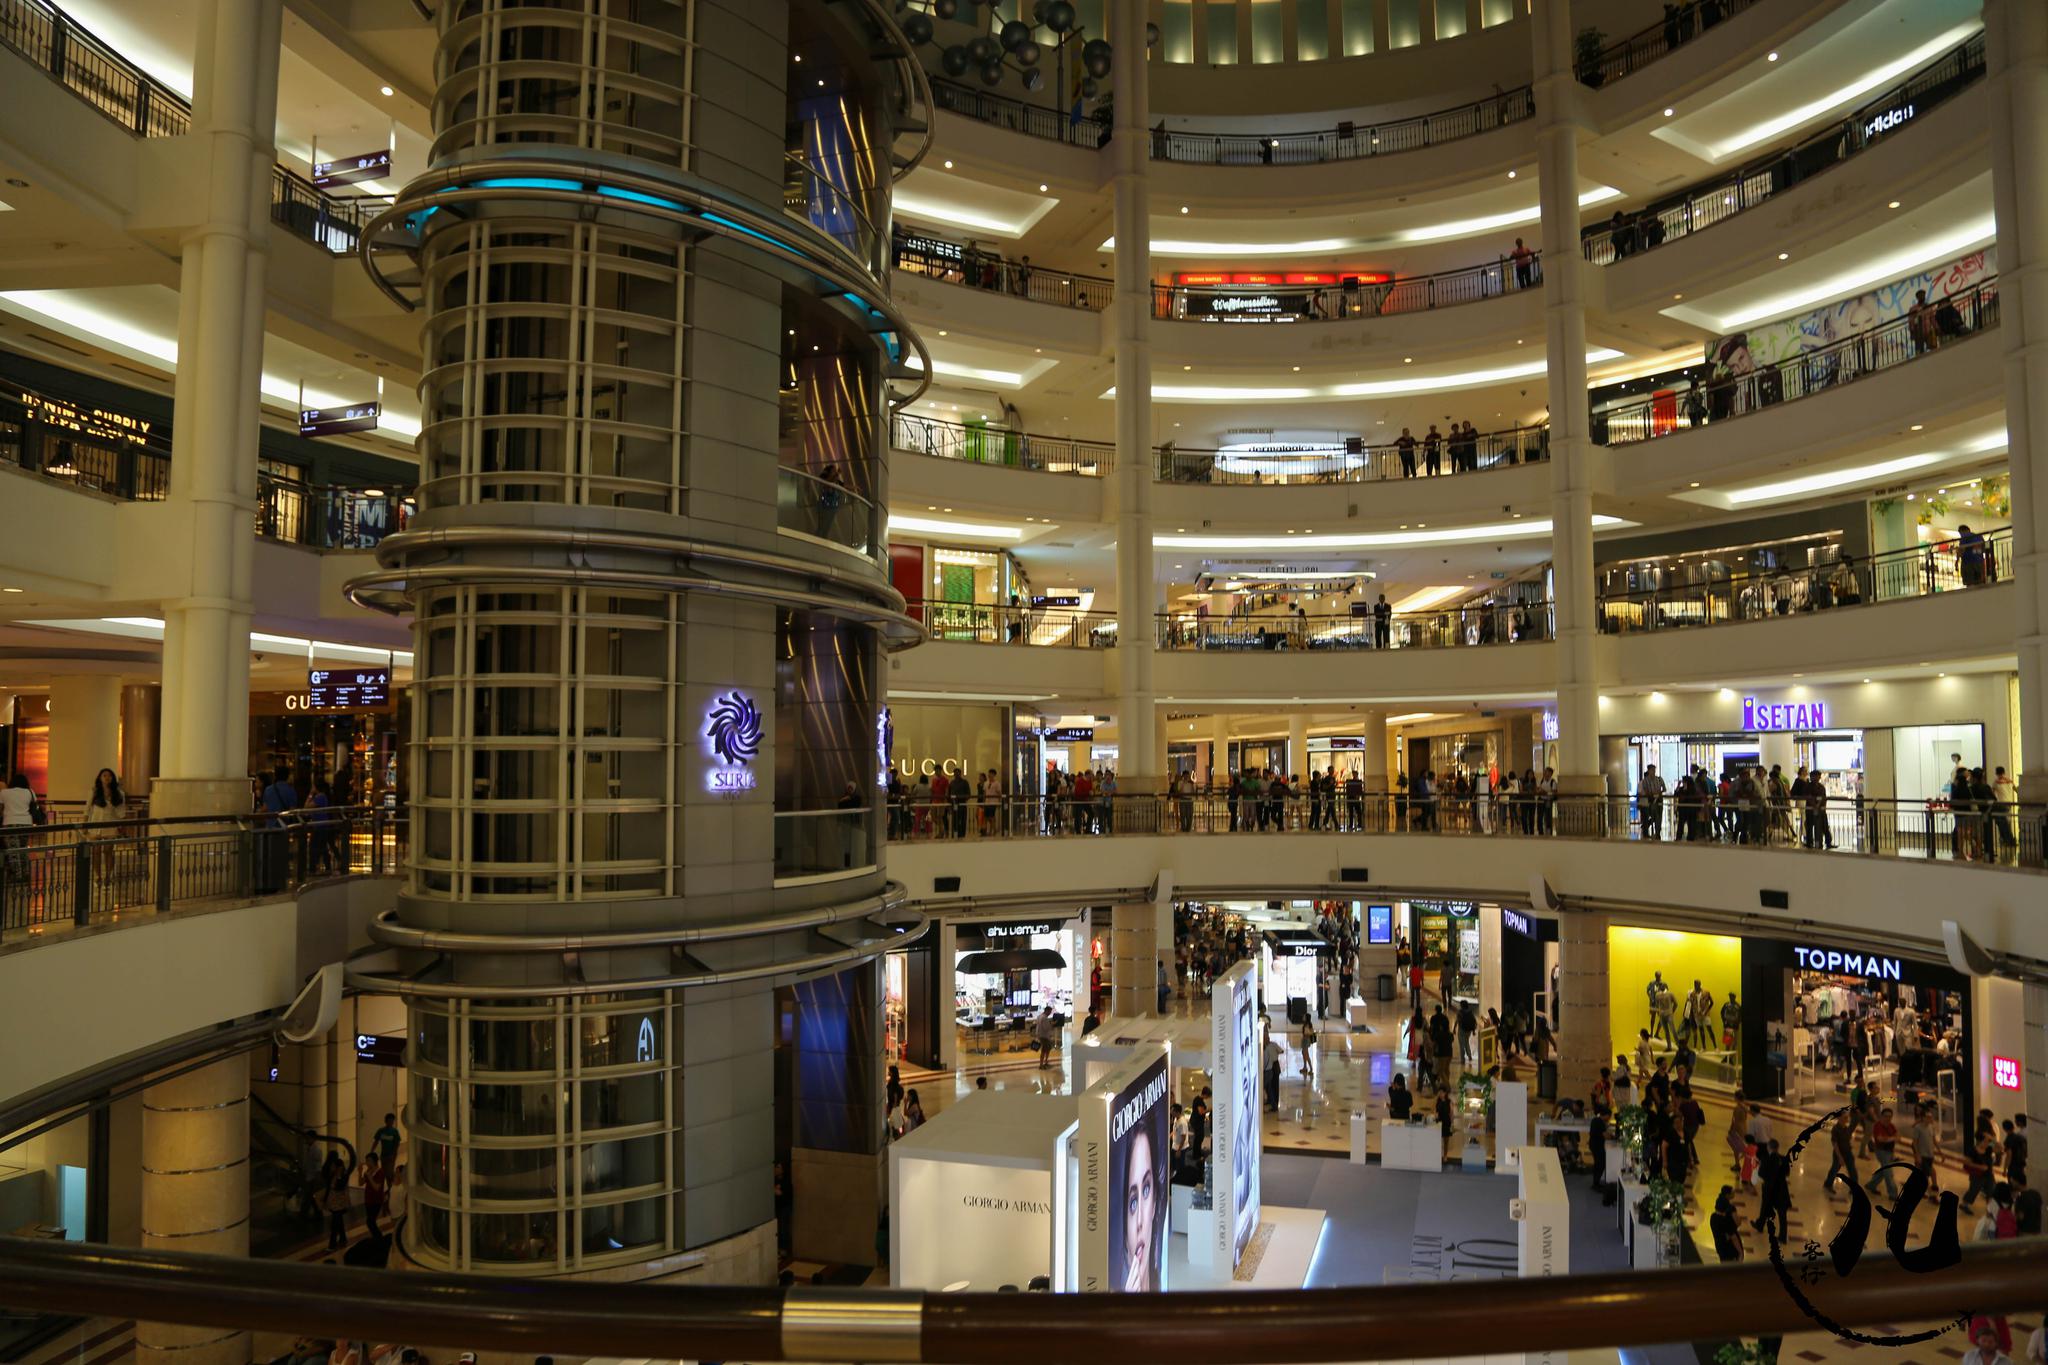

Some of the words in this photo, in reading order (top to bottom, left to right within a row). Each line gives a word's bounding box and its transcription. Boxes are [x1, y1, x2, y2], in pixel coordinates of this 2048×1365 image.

[314, 164, 322, 177] 2
[302, 411, 309, 424] 1
[311, 671, 321, 684] G
[1743, 697, 1825, 730] ISETAN
[890, 758, 967, 776] UCCI
[987, 925, 1008, 937] shu
[1009, 924, 1050, 936] uemura
[1504, 908, 1528, 935] TOPMAN
[1294, 946, 1318, 956] Dior
[1794, 947, 1900, 981] TOPMAN
[357, 1035, 368, 1049] C
[1995, 1058, 2016, 1075] UNI
[1112, 1092, 1144, 1142] GIORGIO
[1143, 1069, 1167, 1114] ARMAN
[1086, 1142, 1099, 1184] ARMANI
[963, 1195, 1009, 1211] GIORGIO
[1011, 1200, 1051, 1215] ARMAN
[1086, 1187, 1099, 1232] GIORGIO
[1542, 1225, 1553, 1260] ARMANI
